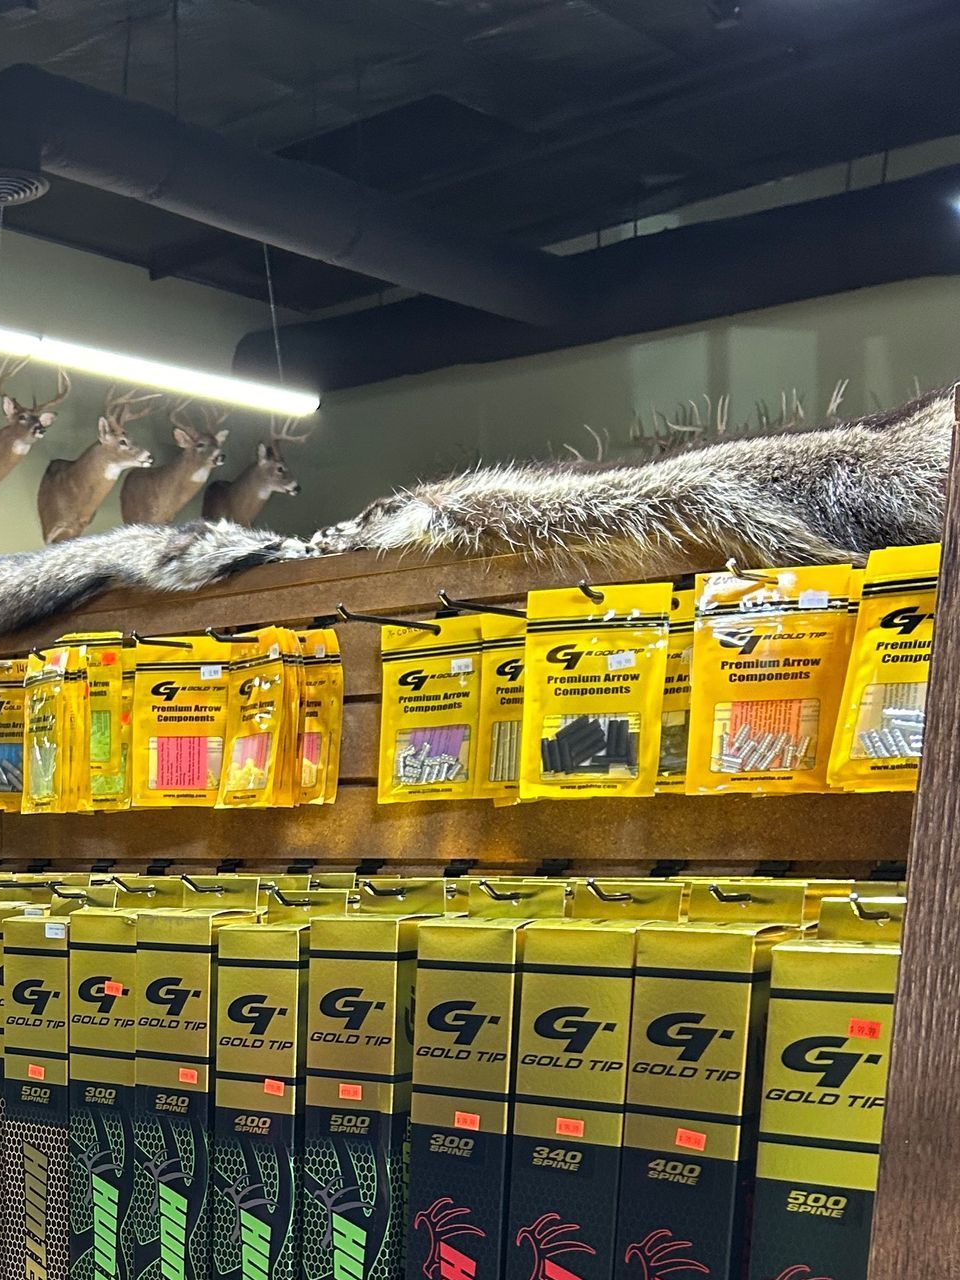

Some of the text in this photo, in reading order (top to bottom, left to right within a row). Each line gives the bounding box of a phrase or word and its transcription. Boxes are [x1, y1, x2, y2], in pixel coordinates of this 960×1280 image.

[720, 656, 822, 670] Premium Arrow
[547, 671, 640, 685] Premium Arrow
[728, 669, 811, 683] Components
[398, 690, 470, 704] Premium Arrow
[554, 684, 631, 697] Components
[151, 704, 222, 713] Premium Arrow
[403, 701, 463, 714] Components
[157, 714, 215, 723] Components
[5, 1015, 67, 1030] GOLD TIP
[71, 1014, 136, 1029] GOLD TIP
[137, 1017, 208, 1032] GOLD TIP
[218, 1036, 294, 1051] GOLD TIP
[310, 1031, 392, 1047] GOLD TIP
[415, 1046, 508, 1064] GOLD TIP
[520, 1054, 624, 1073] GOLD TIP
[631, 1062, 741, 1082] GOLD TIP
[20, 1085, 51, 1098] 500
[84, 1086, 117, 1099] 300
[765, 1088, 840, 1106] GOLD
[21, 1095, 50, 1105] SPINE
[84, 1096, 115, 1106] SPINE
[155, 1094, 190, 1107] 340
[155, 1103, 189, 1114] SPINE
[233, 1114, 272, 1129] 400
[329, 1114, 371, 1128] 500
[233, 1125, 271, 1136] SPINE
[329, 1125, 370, 1136] SPINE
[429, 1133, 475, 1150] 300
[428, 1145, 472, 1158] SPINE
[532, 1146, 584, 1164] 340
[531, 1157, 580, 1172] SPINE
[647, 1157, 702, 1177] 400
[646, 1170, 698, 1186] SPINE
[787, 1189, 848, 1210] 500
[786, 1203, 845, 1218] SPINE
